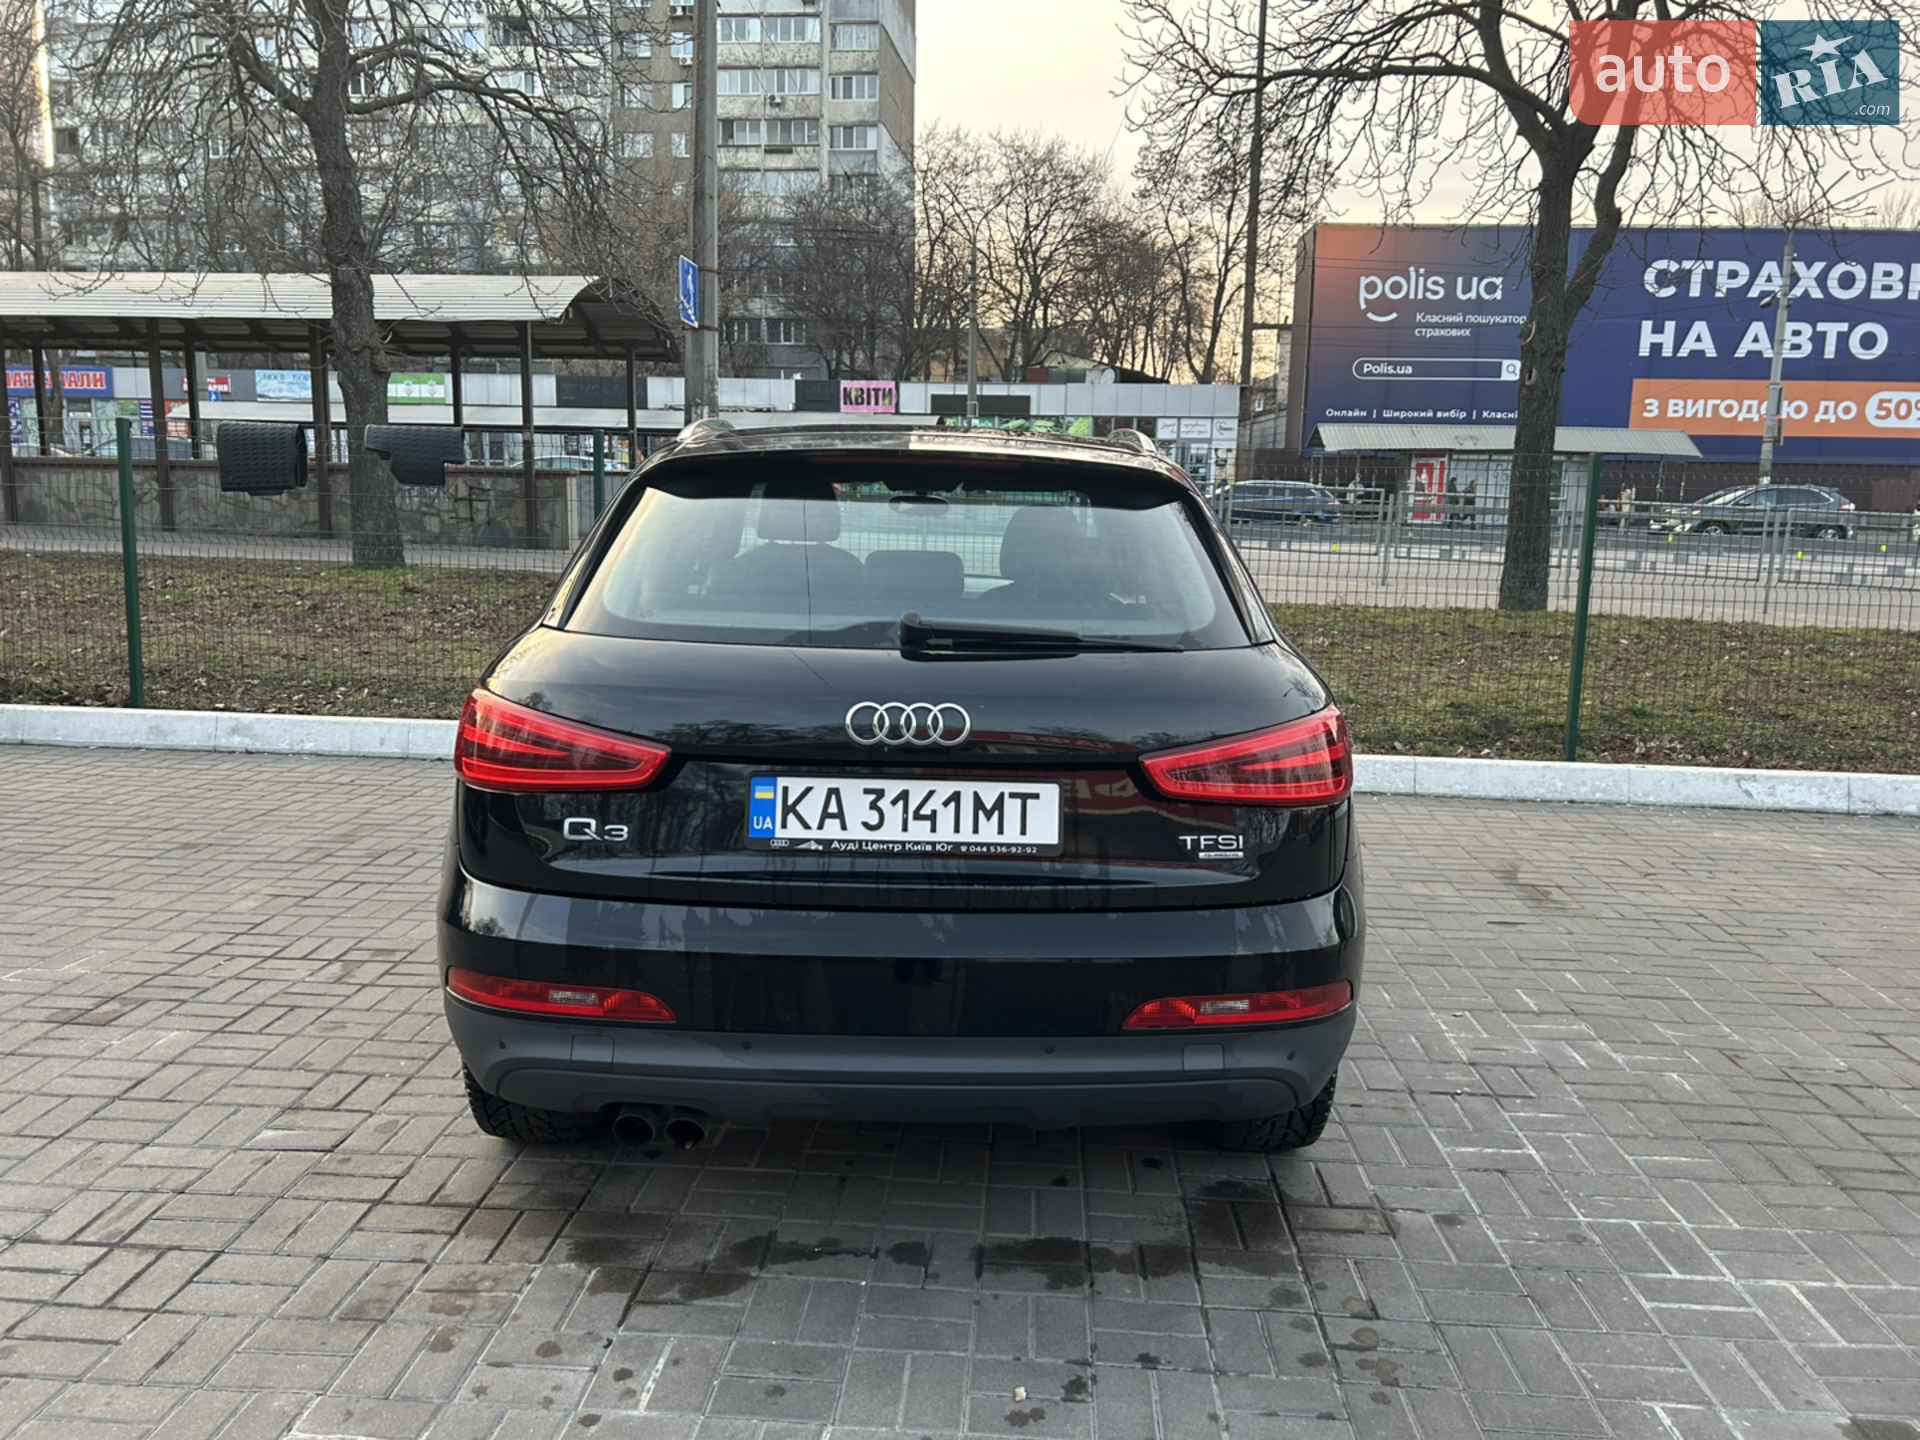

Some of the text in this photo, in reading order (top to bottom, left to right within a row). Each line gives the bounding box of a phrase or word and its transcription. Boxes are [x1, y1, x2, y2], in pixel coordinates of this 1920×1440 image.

[1358, 266, 1504, 310] polis ua
[1415, 311, 1527, 326] Класний пошукатор
[1414, 327, 1471, 338] страхових
[1638, 320, 1889, 361] НА АВТО
[1362, 362, 1413, 375] Polis.ua
[843, 386, 893, 406] КВІТИ
[1325, 408, 1367, 418] Онлайн
[1382, 408, 1434, 420] Широкий
[1436, 408, 1467, 421] вибір
[1814, 401, 1858, 423] ДО
[780, 785, 848, 831] KA
[563, 817, 629, 841] Q3
[753, 815, 773, 830] UA
[831, 840, 1037, 854] Ауді Центр Київ Юг 044 536-92-92
[1178, 834, 1244, 851] TFSI
